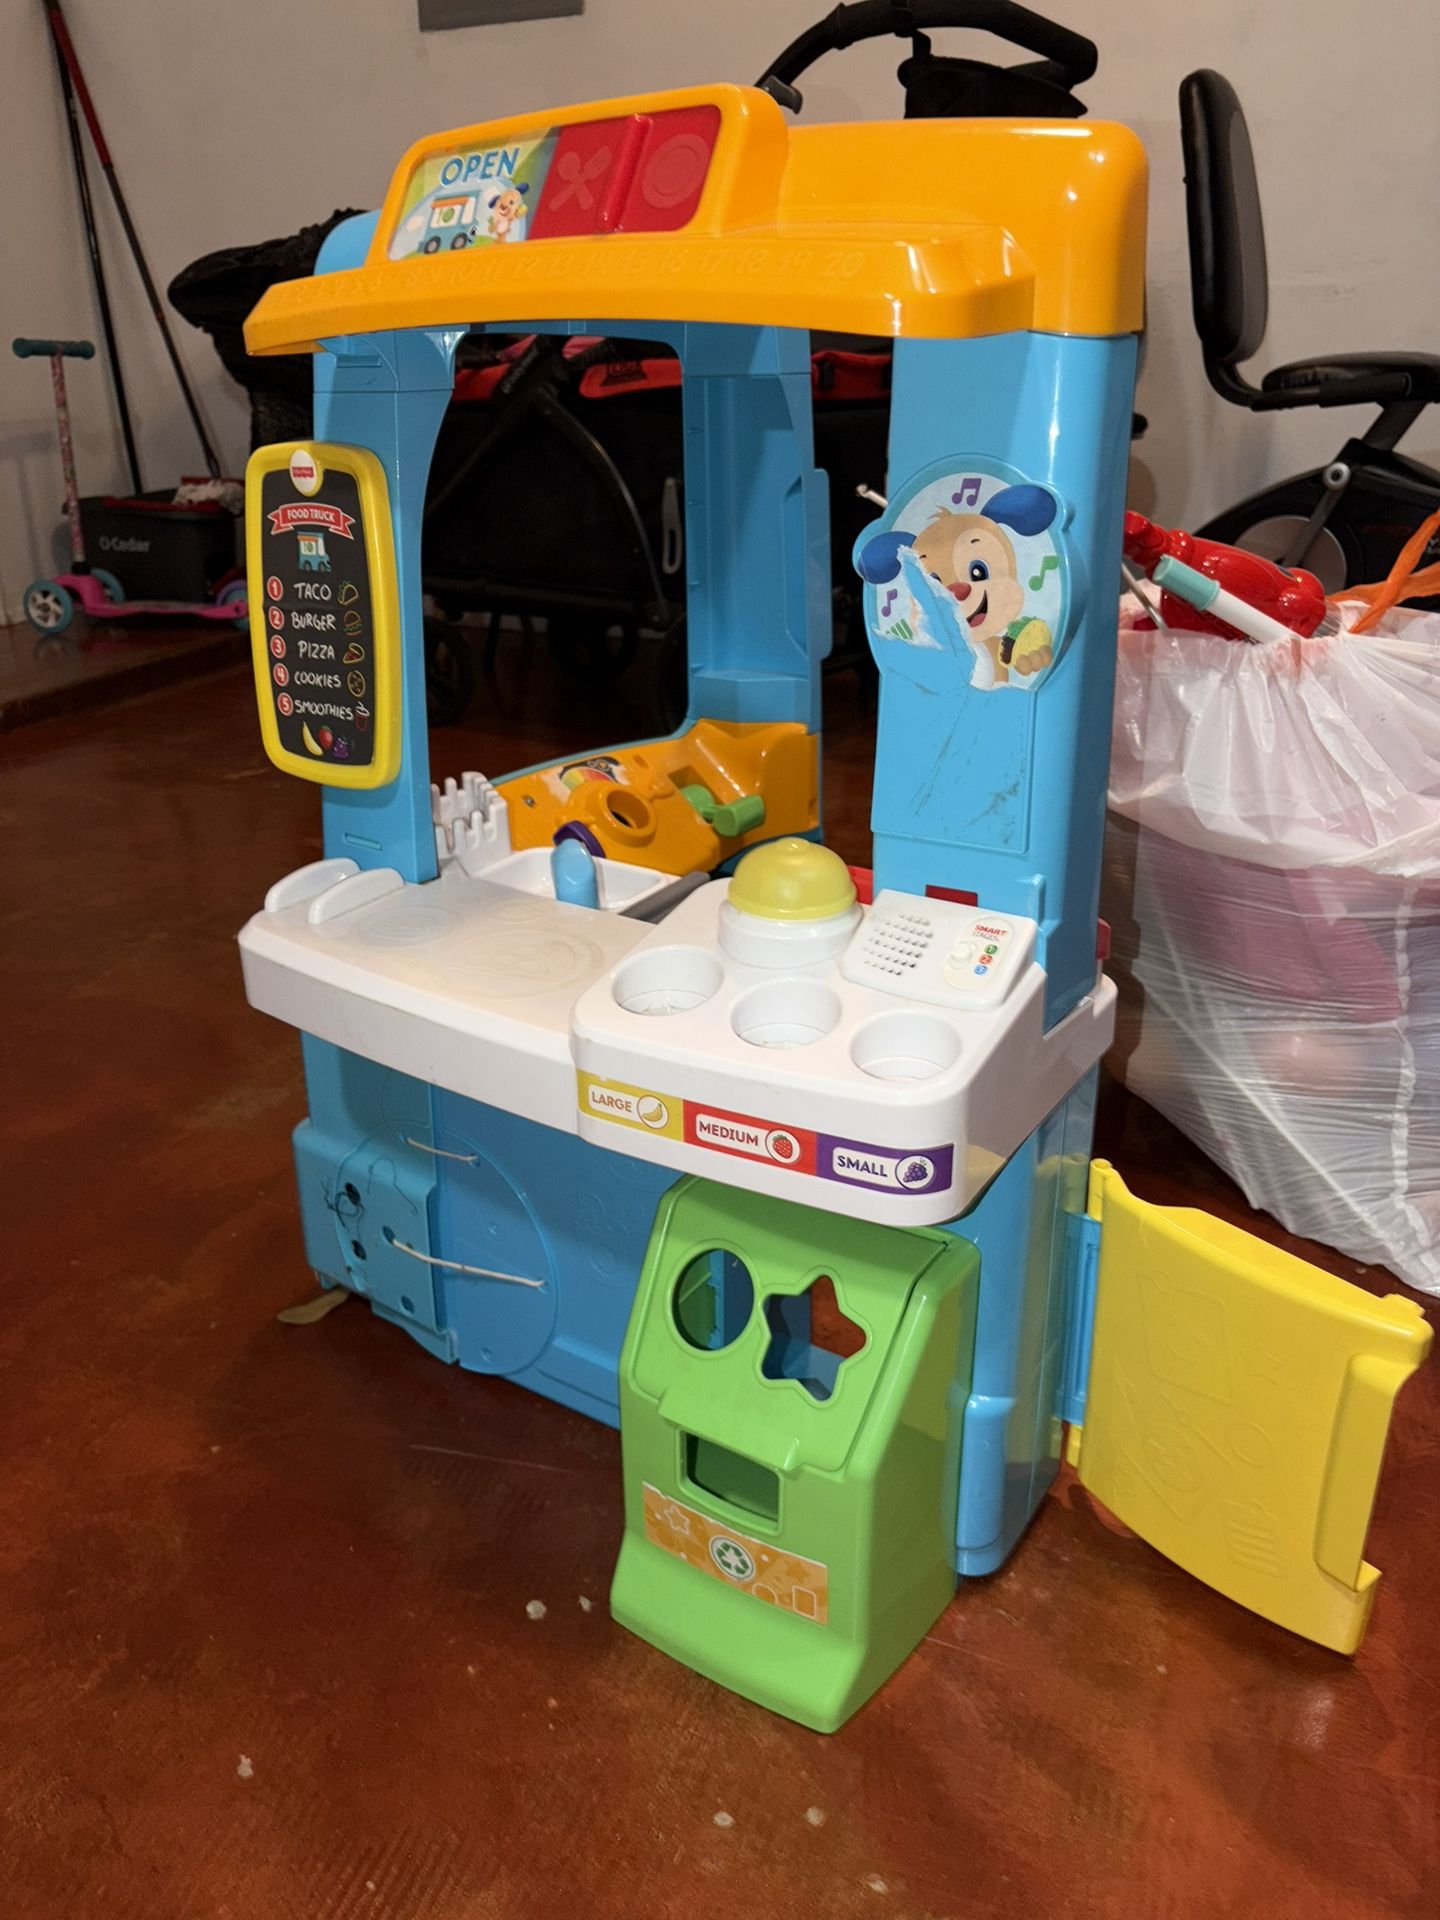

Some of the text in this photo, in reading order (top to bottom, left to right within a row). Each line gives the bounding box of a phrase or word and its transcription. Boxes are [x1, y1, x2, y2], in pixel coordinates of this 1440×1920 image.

[441, 147, 519, 185] OPEN
[821, 250, 865, 278] 20
[287, 508, 335, 522] FOOD TRUCK
[293, 582, 332, 600] TACO
[291, 611, 337, 632] BURGER
[297, 640, 336, 660] PIZZA
[294, 670, 342, 689] COOKIES
[294, 699, 355, 721] SMOOTHIES
[975, 924, 1008, 936] SMART
[592, 1090, 632, 1114] LARGE
[699, 1119, 758, 1147] MEDIUM
[836, 1154, 888, 1178] SMALL
